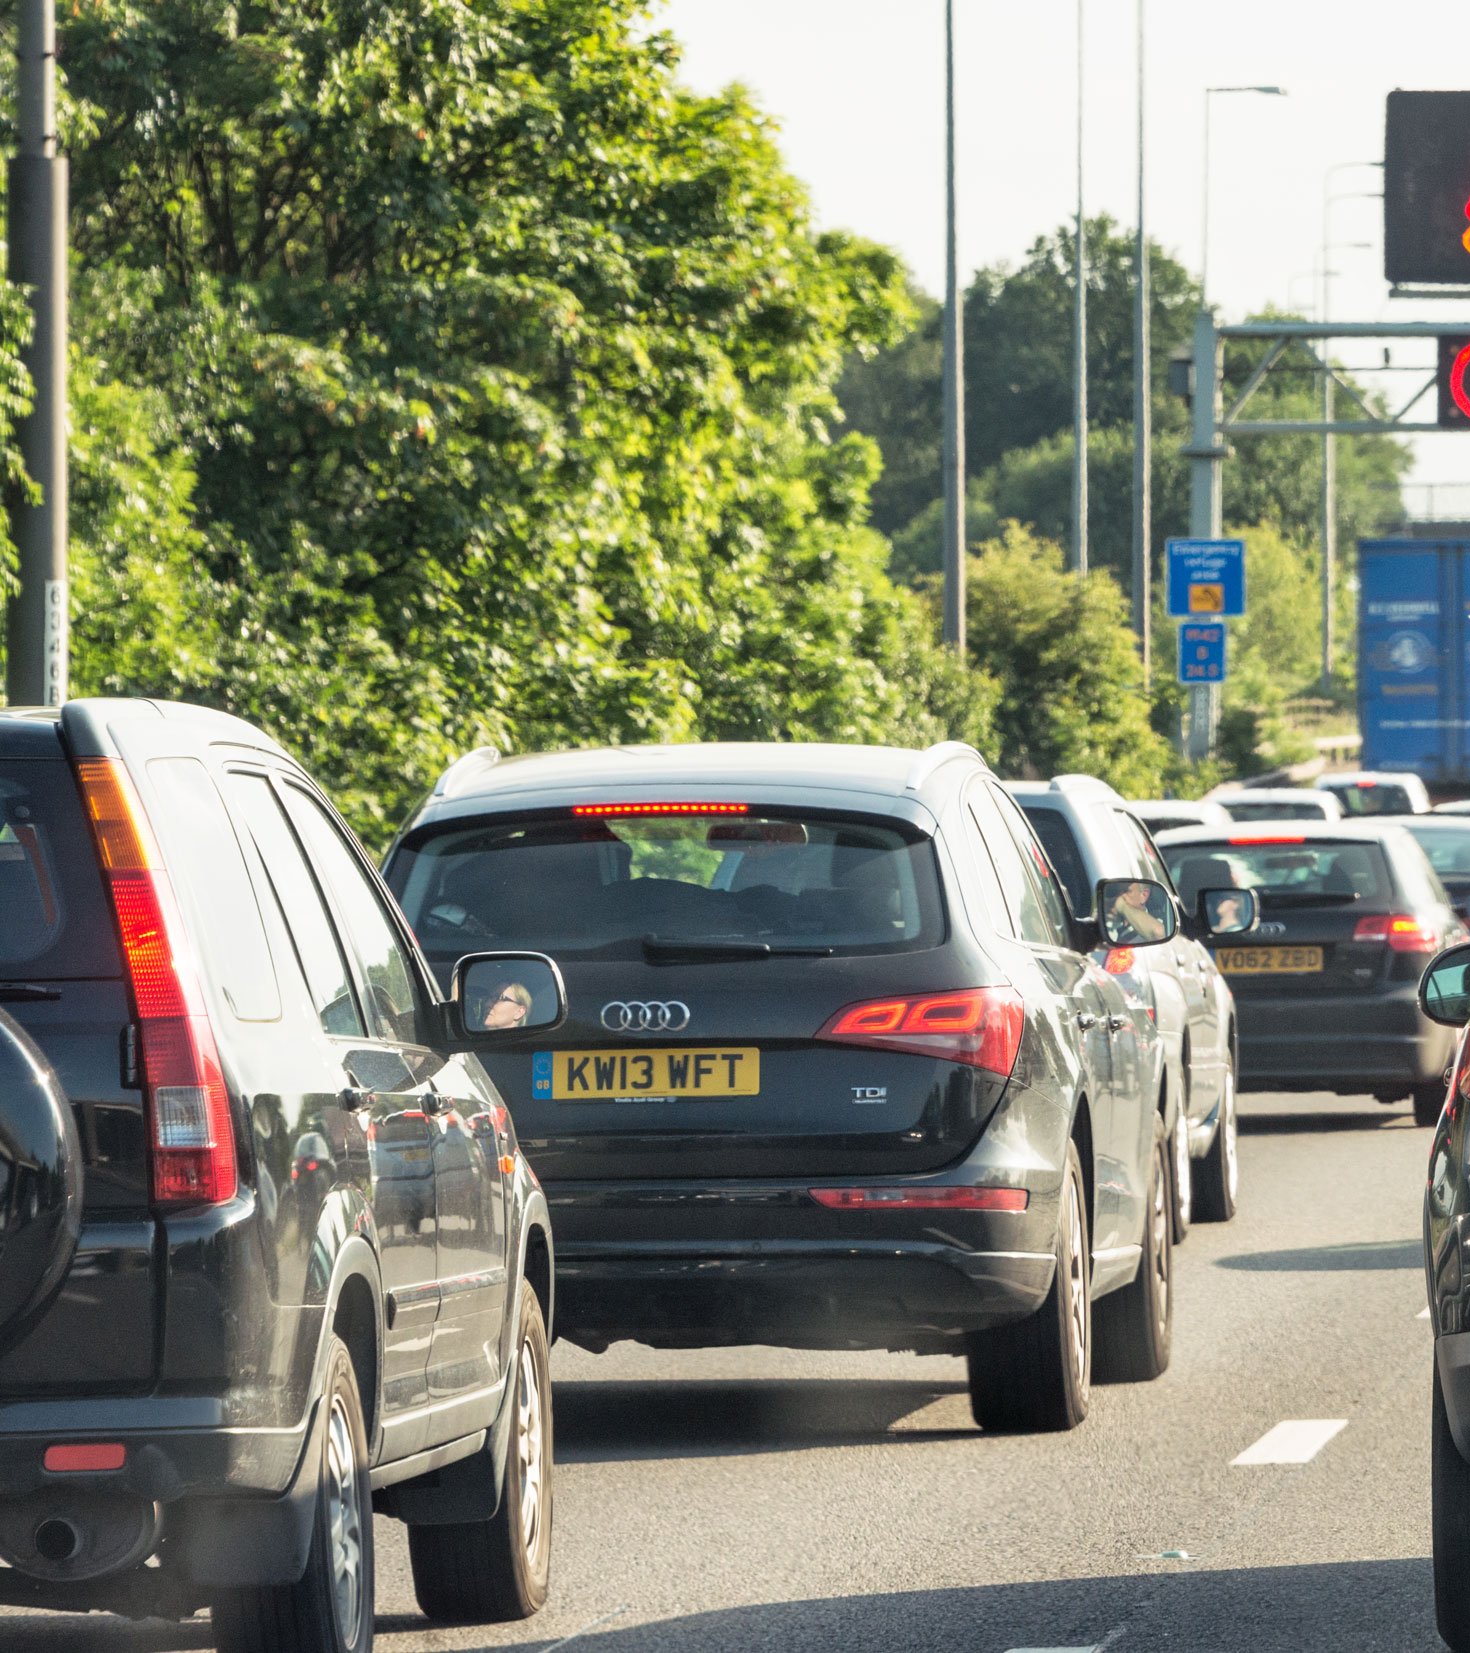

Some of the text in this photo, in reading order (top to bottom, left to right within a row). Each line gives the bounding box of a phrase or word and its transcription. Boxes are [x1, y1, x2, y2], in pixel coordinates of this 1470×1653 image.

[567, 1054, 744, 1091] KW13 WFT
[851, 1087, 887, 1098] TDI
